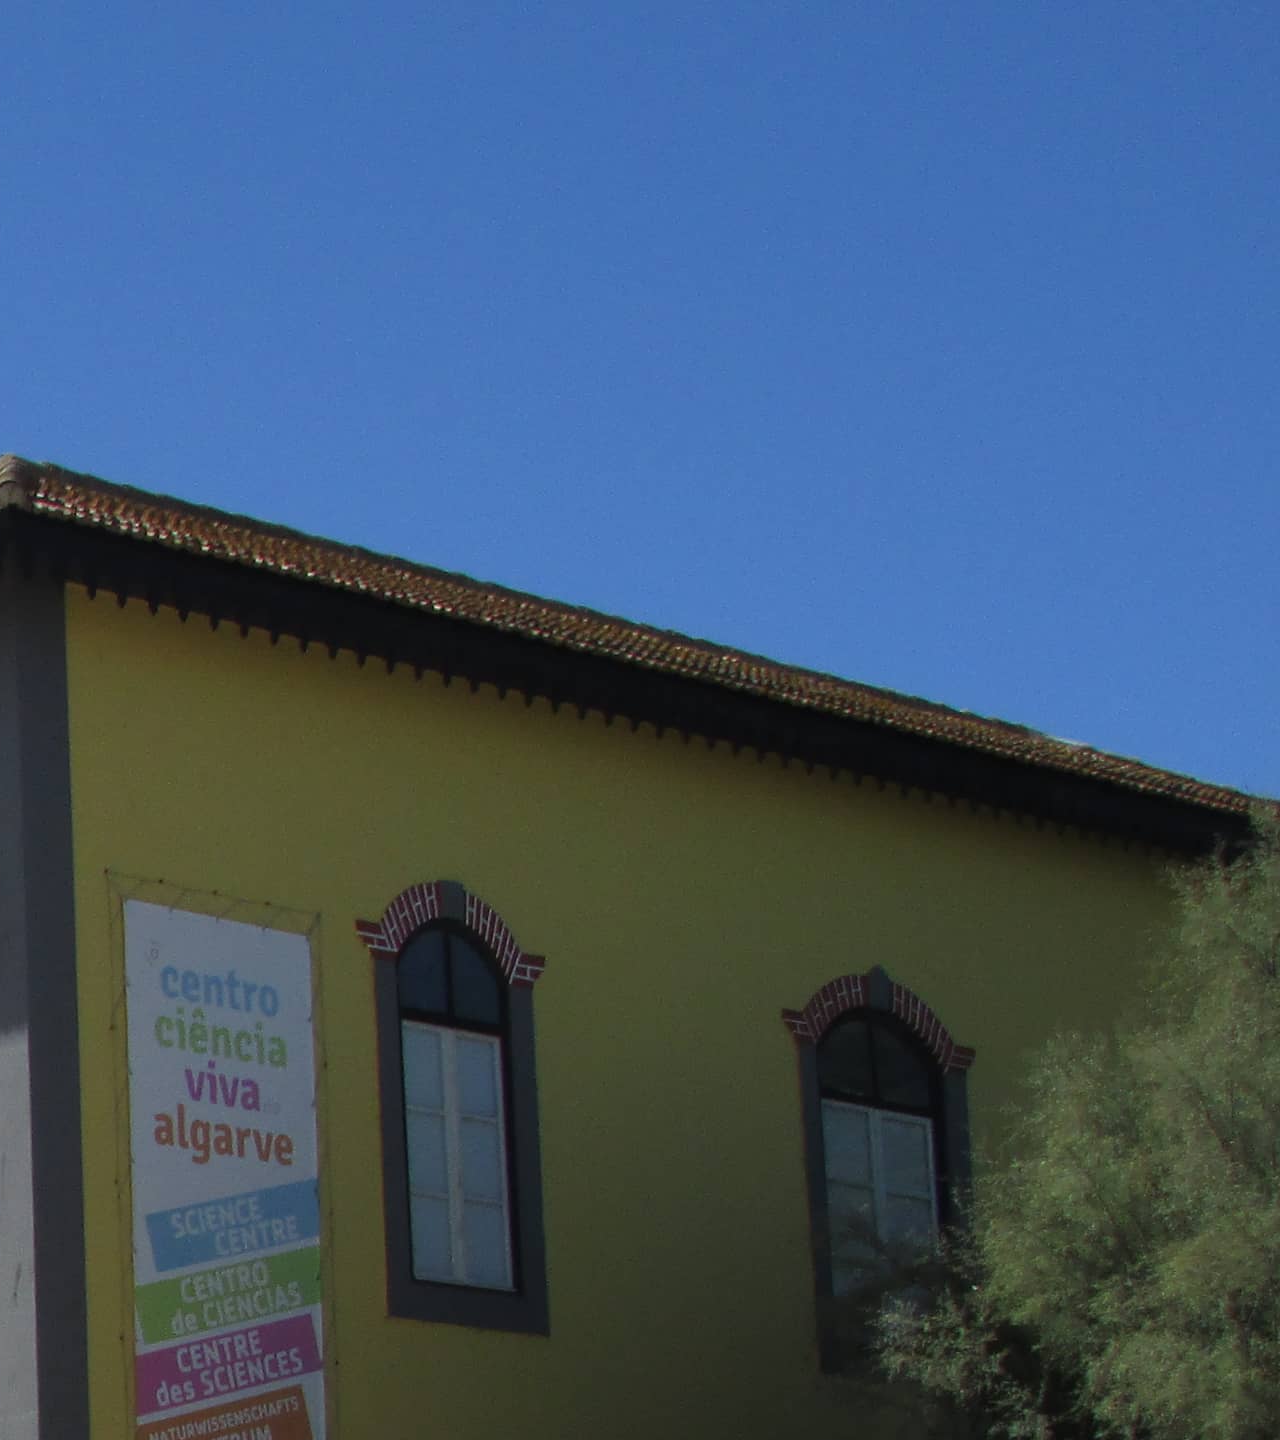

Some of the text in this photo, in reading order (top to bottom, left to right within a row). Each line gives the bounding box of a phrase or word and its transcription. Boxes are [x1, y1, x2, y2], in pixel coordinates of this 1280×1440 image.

[160, 965, 280, 1018] centro
[154, 1006, 288, 1068] ciência
[184, 1060, 261, 1112] viva
[153, 1103, 294, 1166] algarve
[170, 1196, 265, 1239] SCIENCE
[213, 1215, 301, 1256] CENTRE
[180, 1261, 271, 1302] CENTRO
[170, 1281, 305, 1336] de CIENCIAS
[156, 1348, 304, 1407] des SCIENCES
[175, 1330, 265, 1374] CENTRE
